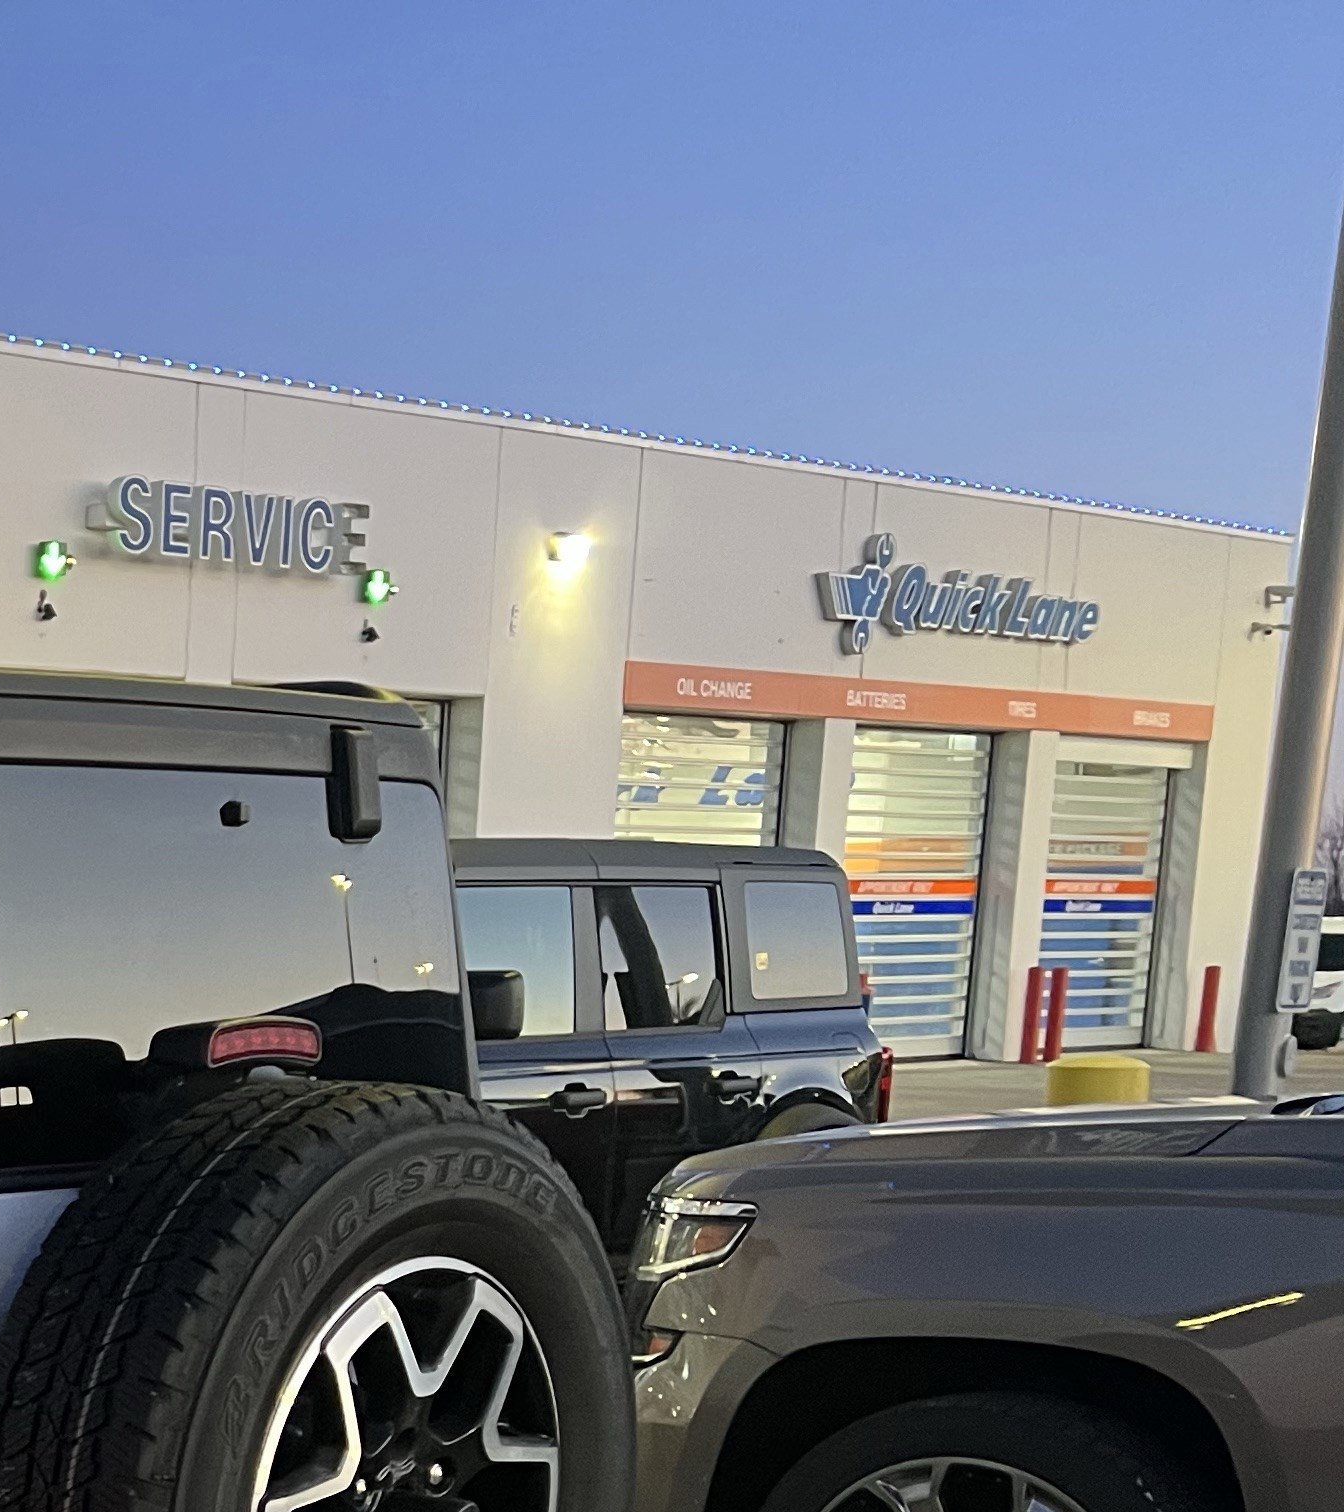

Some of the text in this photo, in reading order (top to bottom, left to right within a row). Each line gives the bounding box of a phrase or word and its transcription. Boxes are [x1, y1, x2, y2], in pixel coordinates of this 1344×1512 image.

[118, 473, 370, 575] SERVICE
[891, 561, 1102, 644] Quick Lane
[676, 677, 753, 700] OIL CHANGE
[846, 689, 907, 710] BATTERIES
[220, 1149, 560, 1457] BRIDGESTONE
